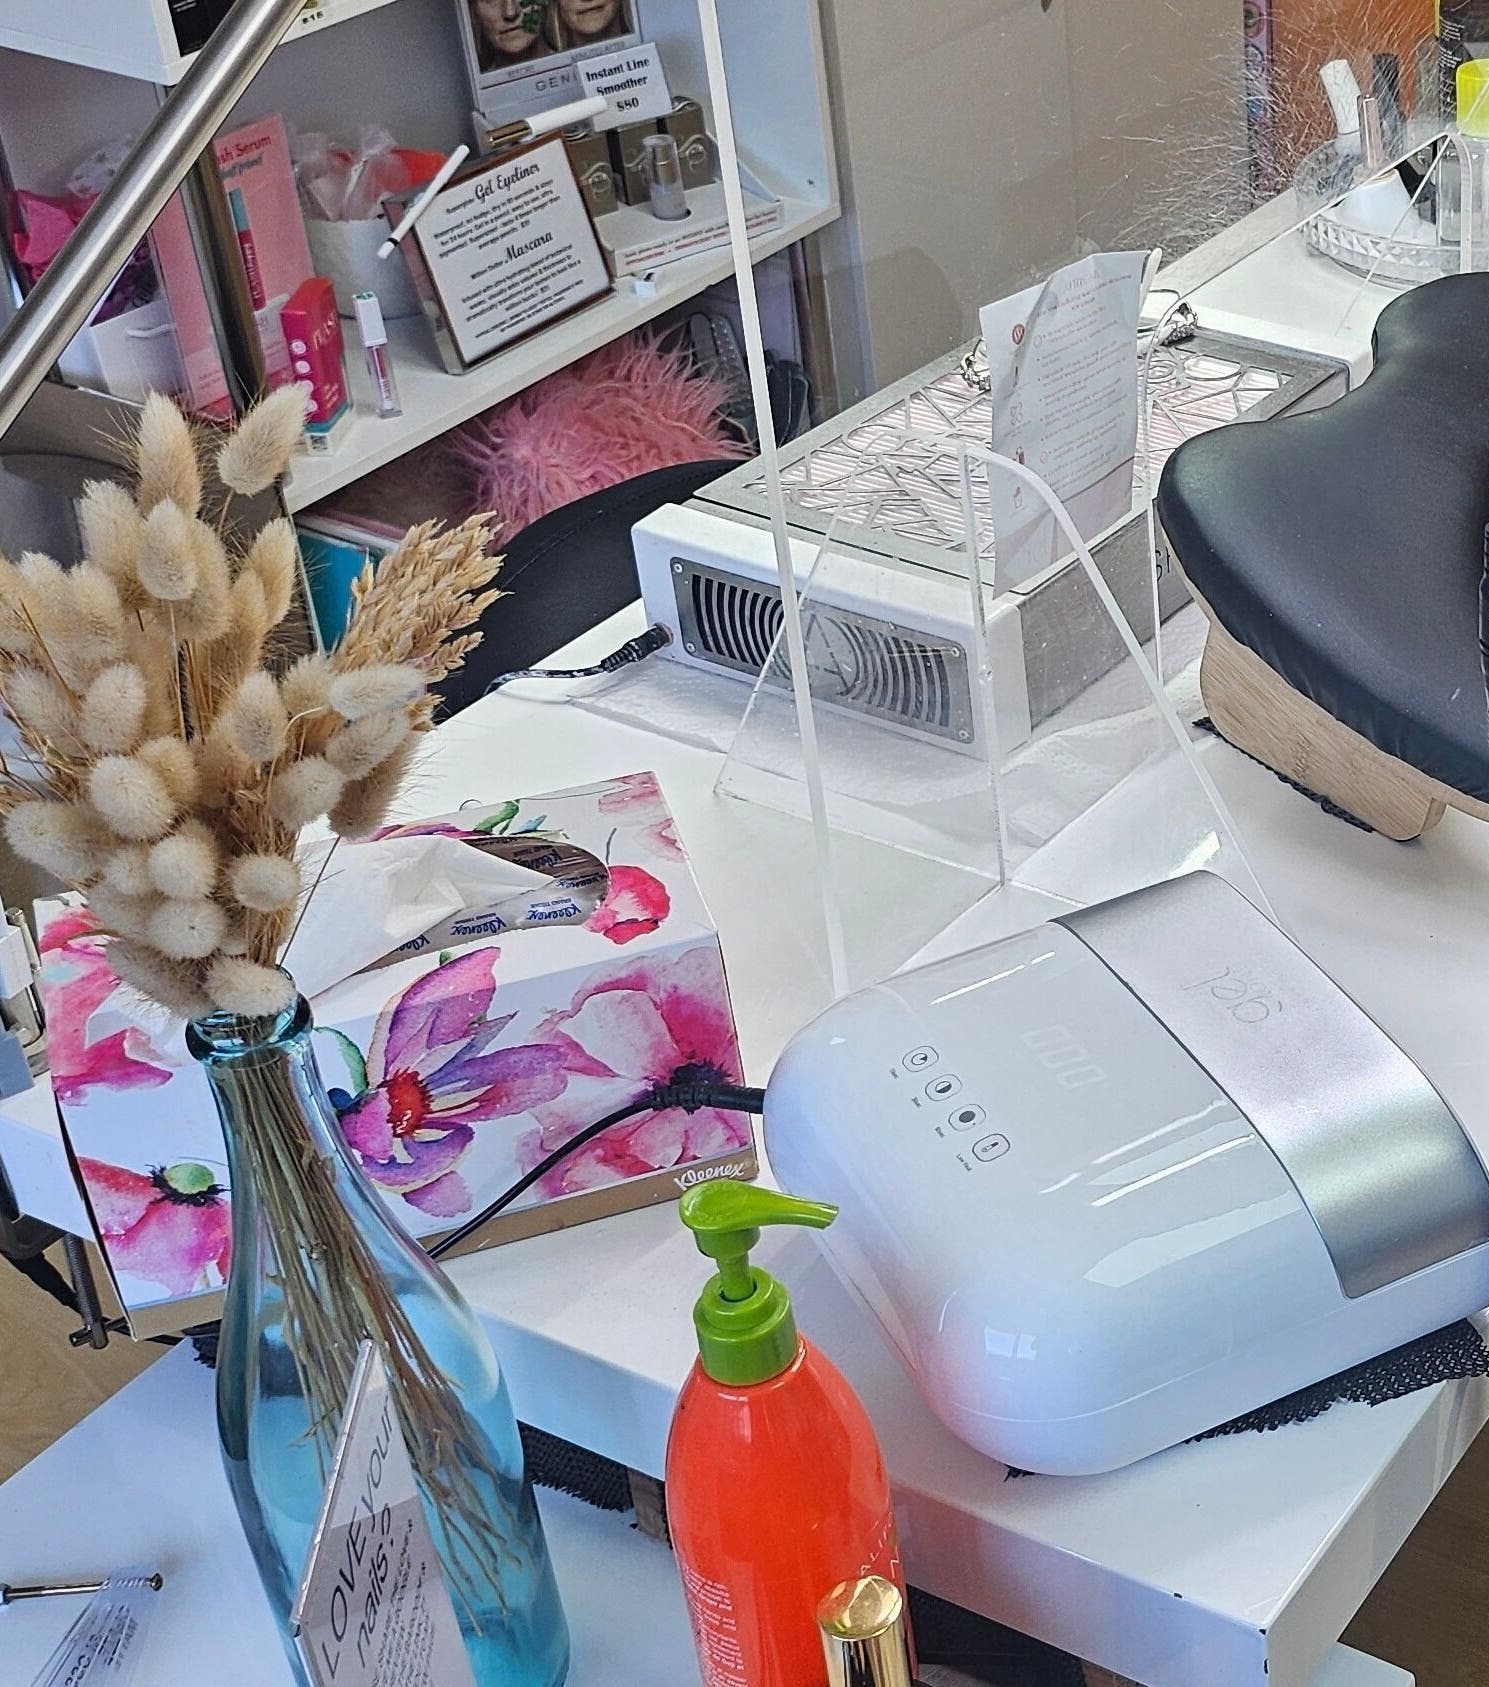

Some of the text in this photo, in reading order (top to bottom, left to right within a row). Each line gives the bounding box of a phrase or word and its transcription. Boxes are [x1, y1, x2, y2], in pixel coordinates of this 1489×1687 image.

[586, 57, 650, 82] Instant Line
[535, 73, 579, 92] GENI
[596, 75, 648, 97] Smoother
[235, 136, 272, 157] Serum
[474, 163, 541, 202] Gel Eyeliner
[504, 231, 554, 264] Mascara
[525, 902, 582, 921] Kleenex
[450, 916, 507, 936] Kleenex
[674, 1162, 745, 1191] Kleenex
[322, 1506, 367, 1680] LOVE
[357, 1502, 395, 1669] nails?
